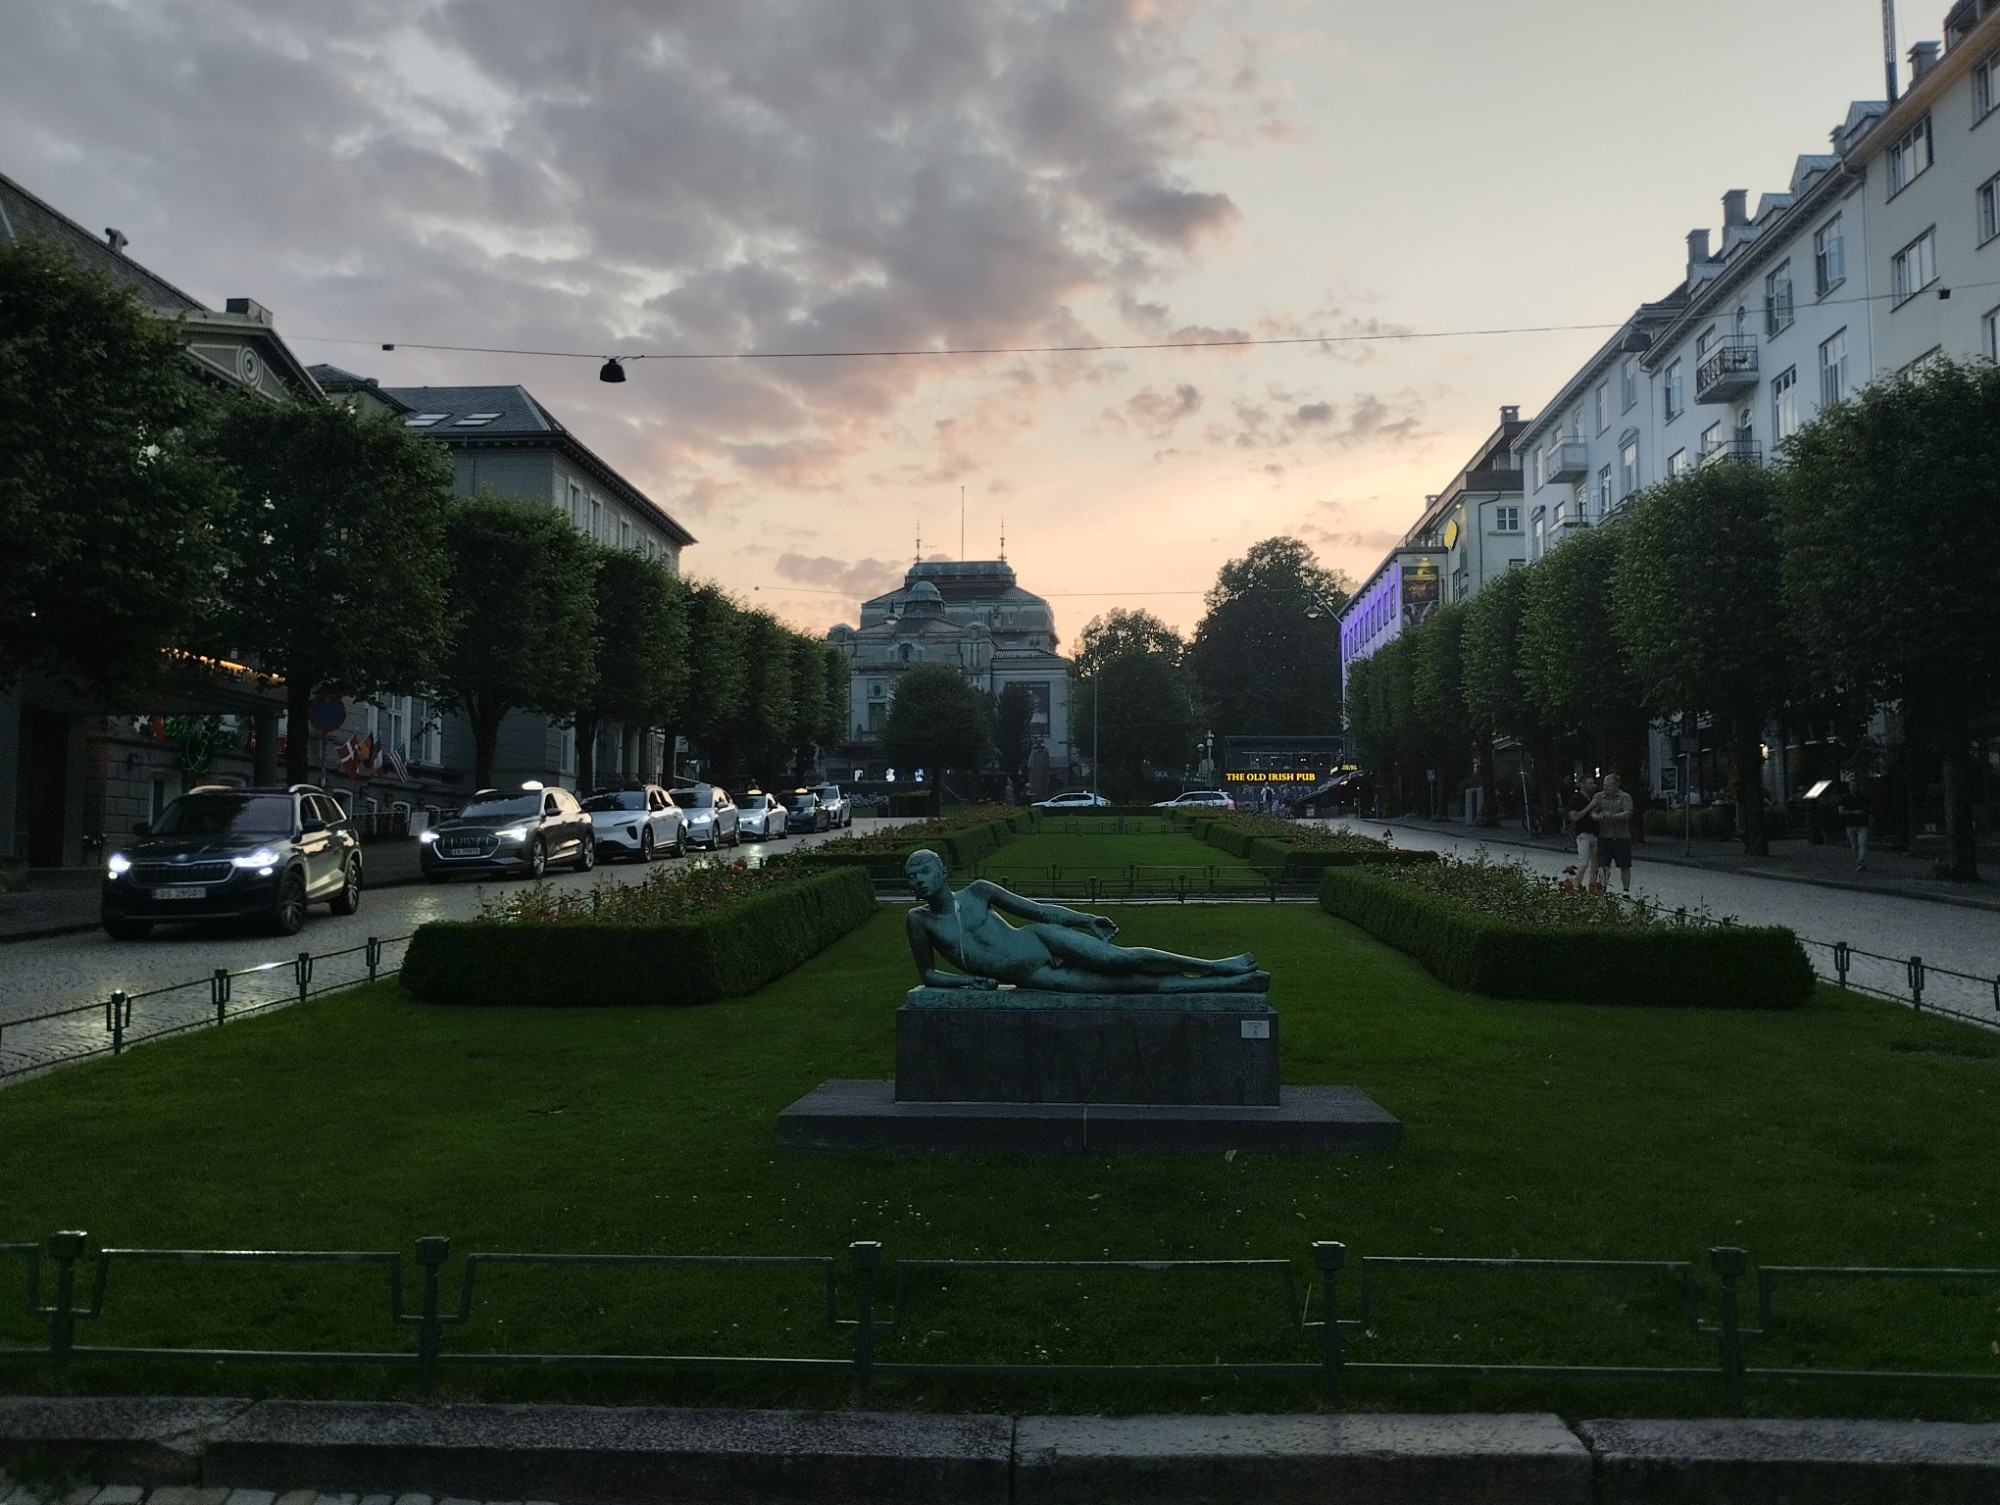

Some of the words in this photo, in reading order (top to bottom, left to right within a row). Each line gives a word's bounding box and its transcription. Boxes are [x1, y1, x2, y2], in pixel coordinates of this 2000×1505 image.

[1226, 773, 1245, 781] THE
[1247, 773, 1266, 781] OLD
[1269, 773, 1294, 781] IRISH
[1296, 773, 1316, 781] PUB
